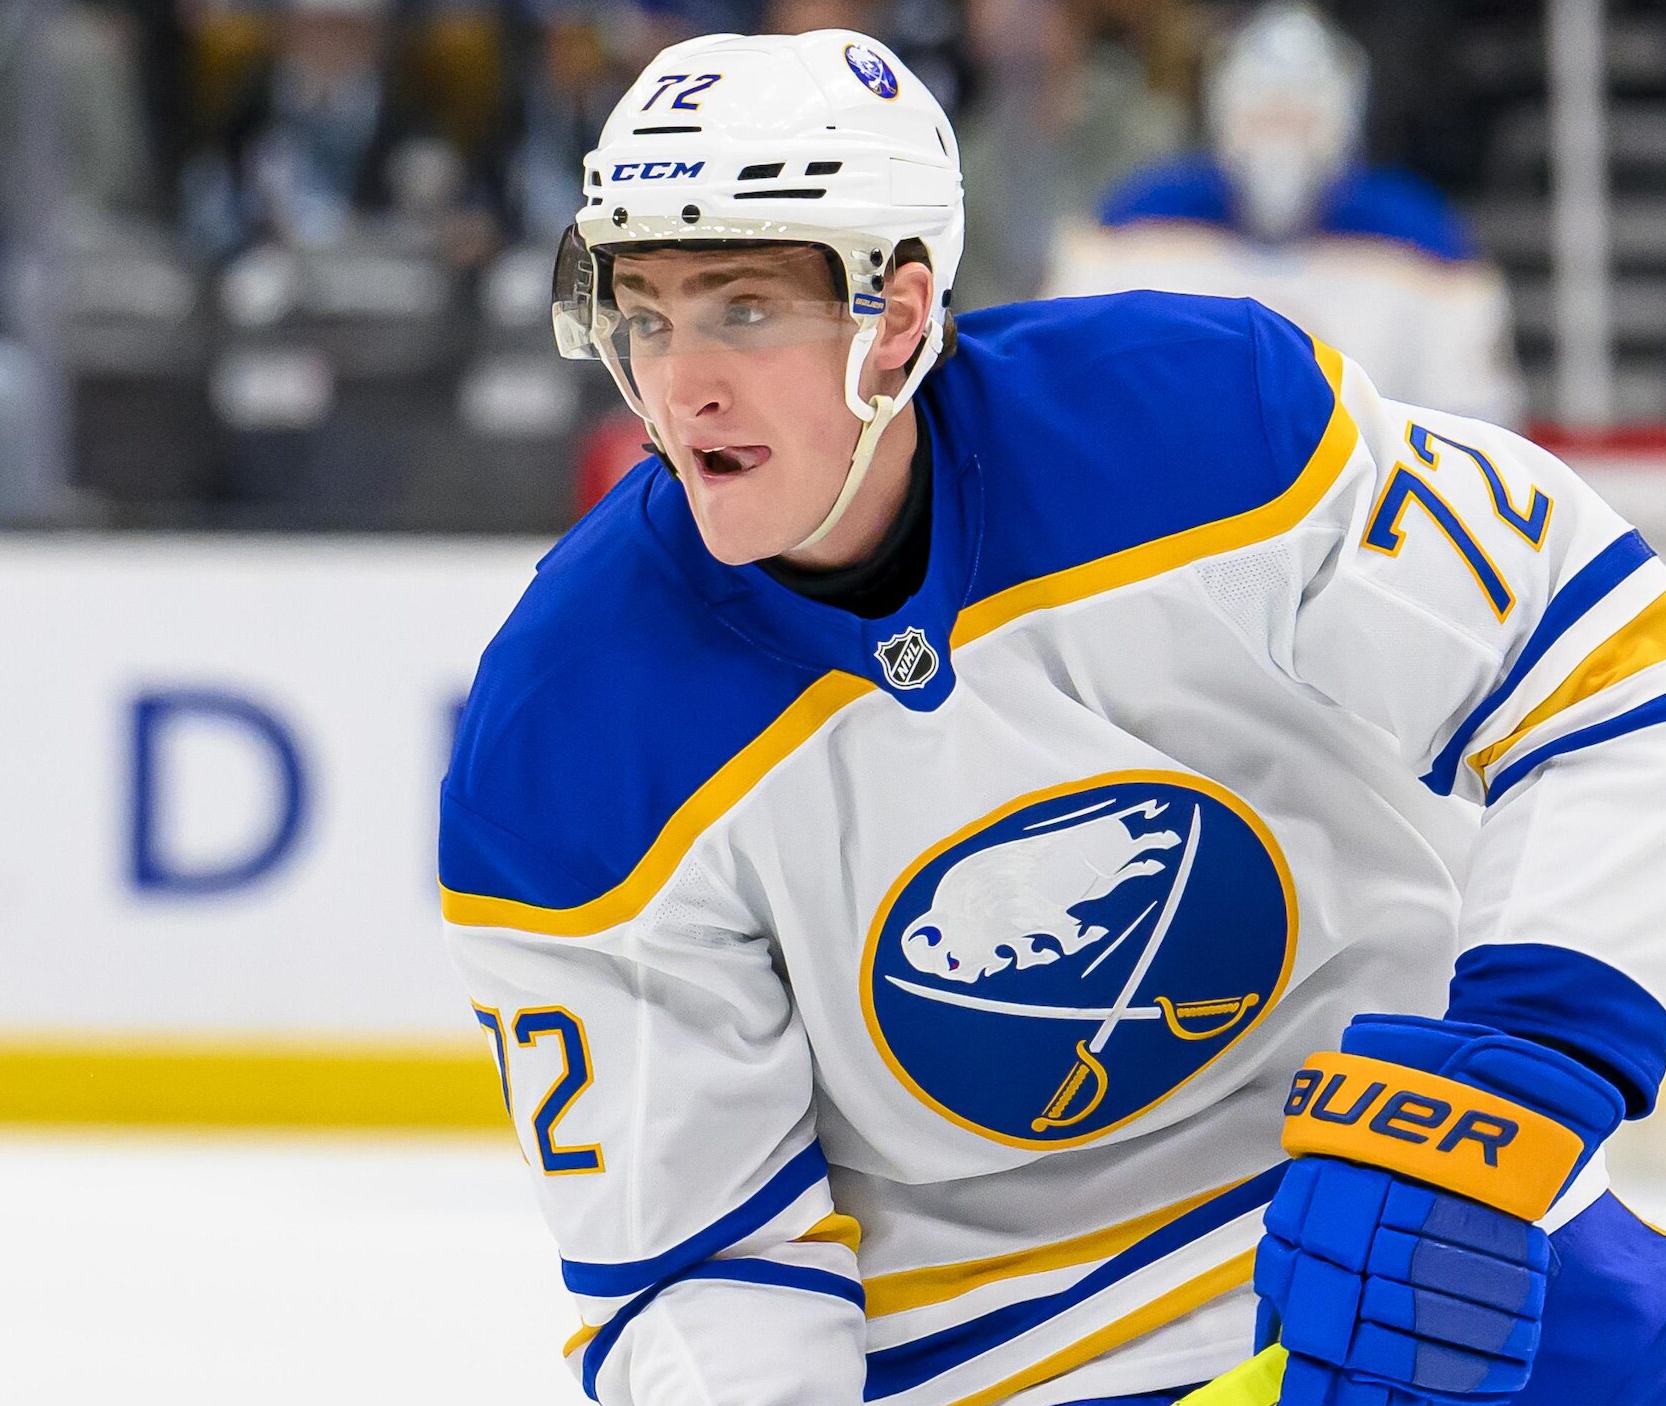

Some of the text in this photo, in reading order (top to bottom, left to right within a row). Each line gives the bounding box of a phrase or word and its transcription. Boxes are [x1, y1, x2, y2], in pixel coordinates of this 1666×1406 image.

[639, 73, 724, 112] 72
[611, 161, 705, 182] CCM
[1360, 419, 1554, 625] 72
[896, 642, 921, 681] NHL
